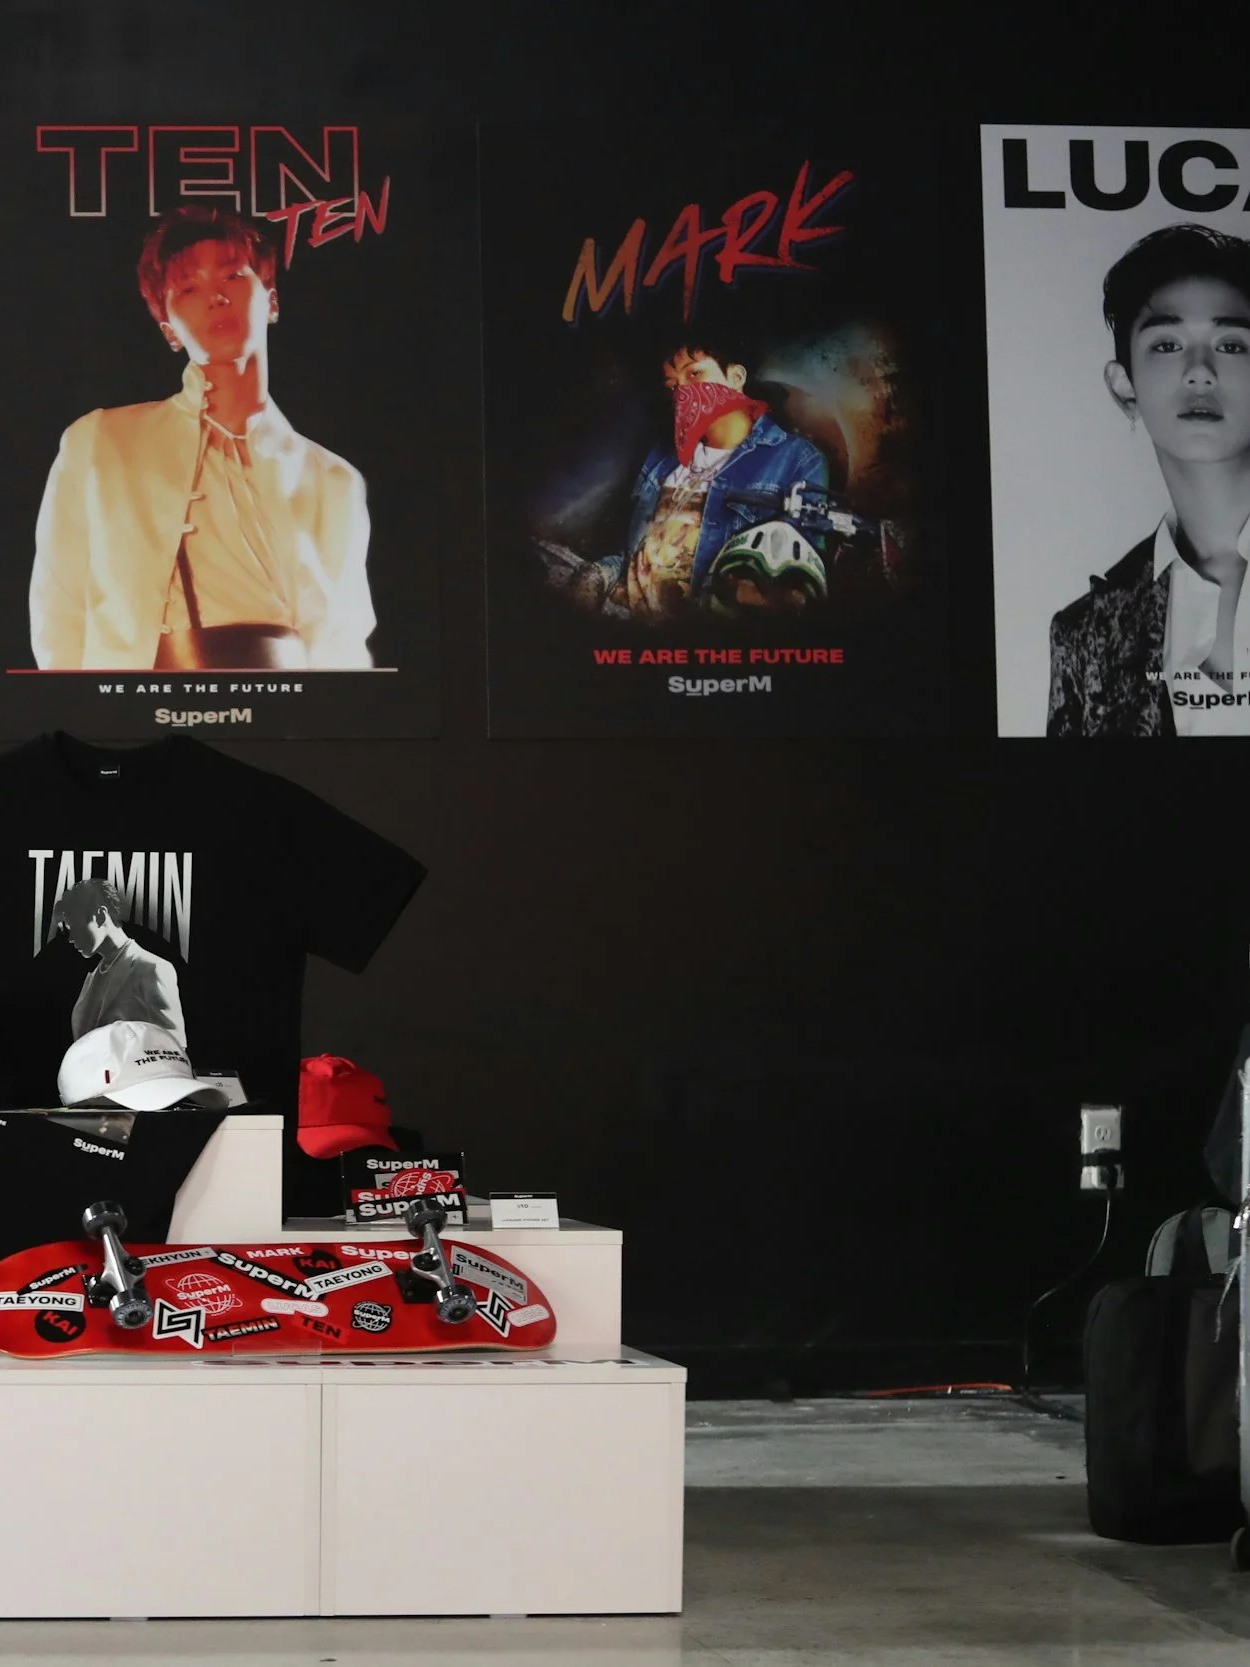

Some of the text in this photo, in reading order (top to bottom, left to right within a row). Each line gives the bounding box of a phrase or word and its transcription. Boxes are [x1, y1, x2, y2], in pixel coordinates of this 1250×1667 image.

[37, 125, 358, 217] TEN
[1002, 138, 1250, 212] LUC
[265, 175, 390, 270] TEN
[562, 159, 853, 325] MARK
[594, 648, 844, 665] WE ARE THE FUTURE
[668, 676, 772, 696] SuperM
[1173, 672, 1201, 680] ARE
[1209, 672, 1234, 680] THE
[99, 683, 304, 693] WE ARE THE FUTURE
[1173, 691, 1250, 709] Super
[155, 708, 253, 726] SuperM
[134, 1056, 158, 1066] THE
[73, 1138, 125, 1160] SuperM
[367, 1159, 440, 1171] SuperM
[359, 1193, 461, 1217] SupM
[246, 1246, 305, 1259] MARK
[301, 1257, 335, 1269] KAI
[29, 1267, 77, 1290] SuperM
[216, 1252, 320, 1301] SuperM
[313, 1265, 384, 1290] TAEYONG
[456, 1253, 524, 1291] SuperM
[176, 1284, 231, 1300] SuperM
[43, 1311, 78, 1336] KAI
[353, 1308, 391, 1323] SuperM
[205, 1318, 279, 1341] TAEMIN
[302, 1316, 342, 1340] TEN
